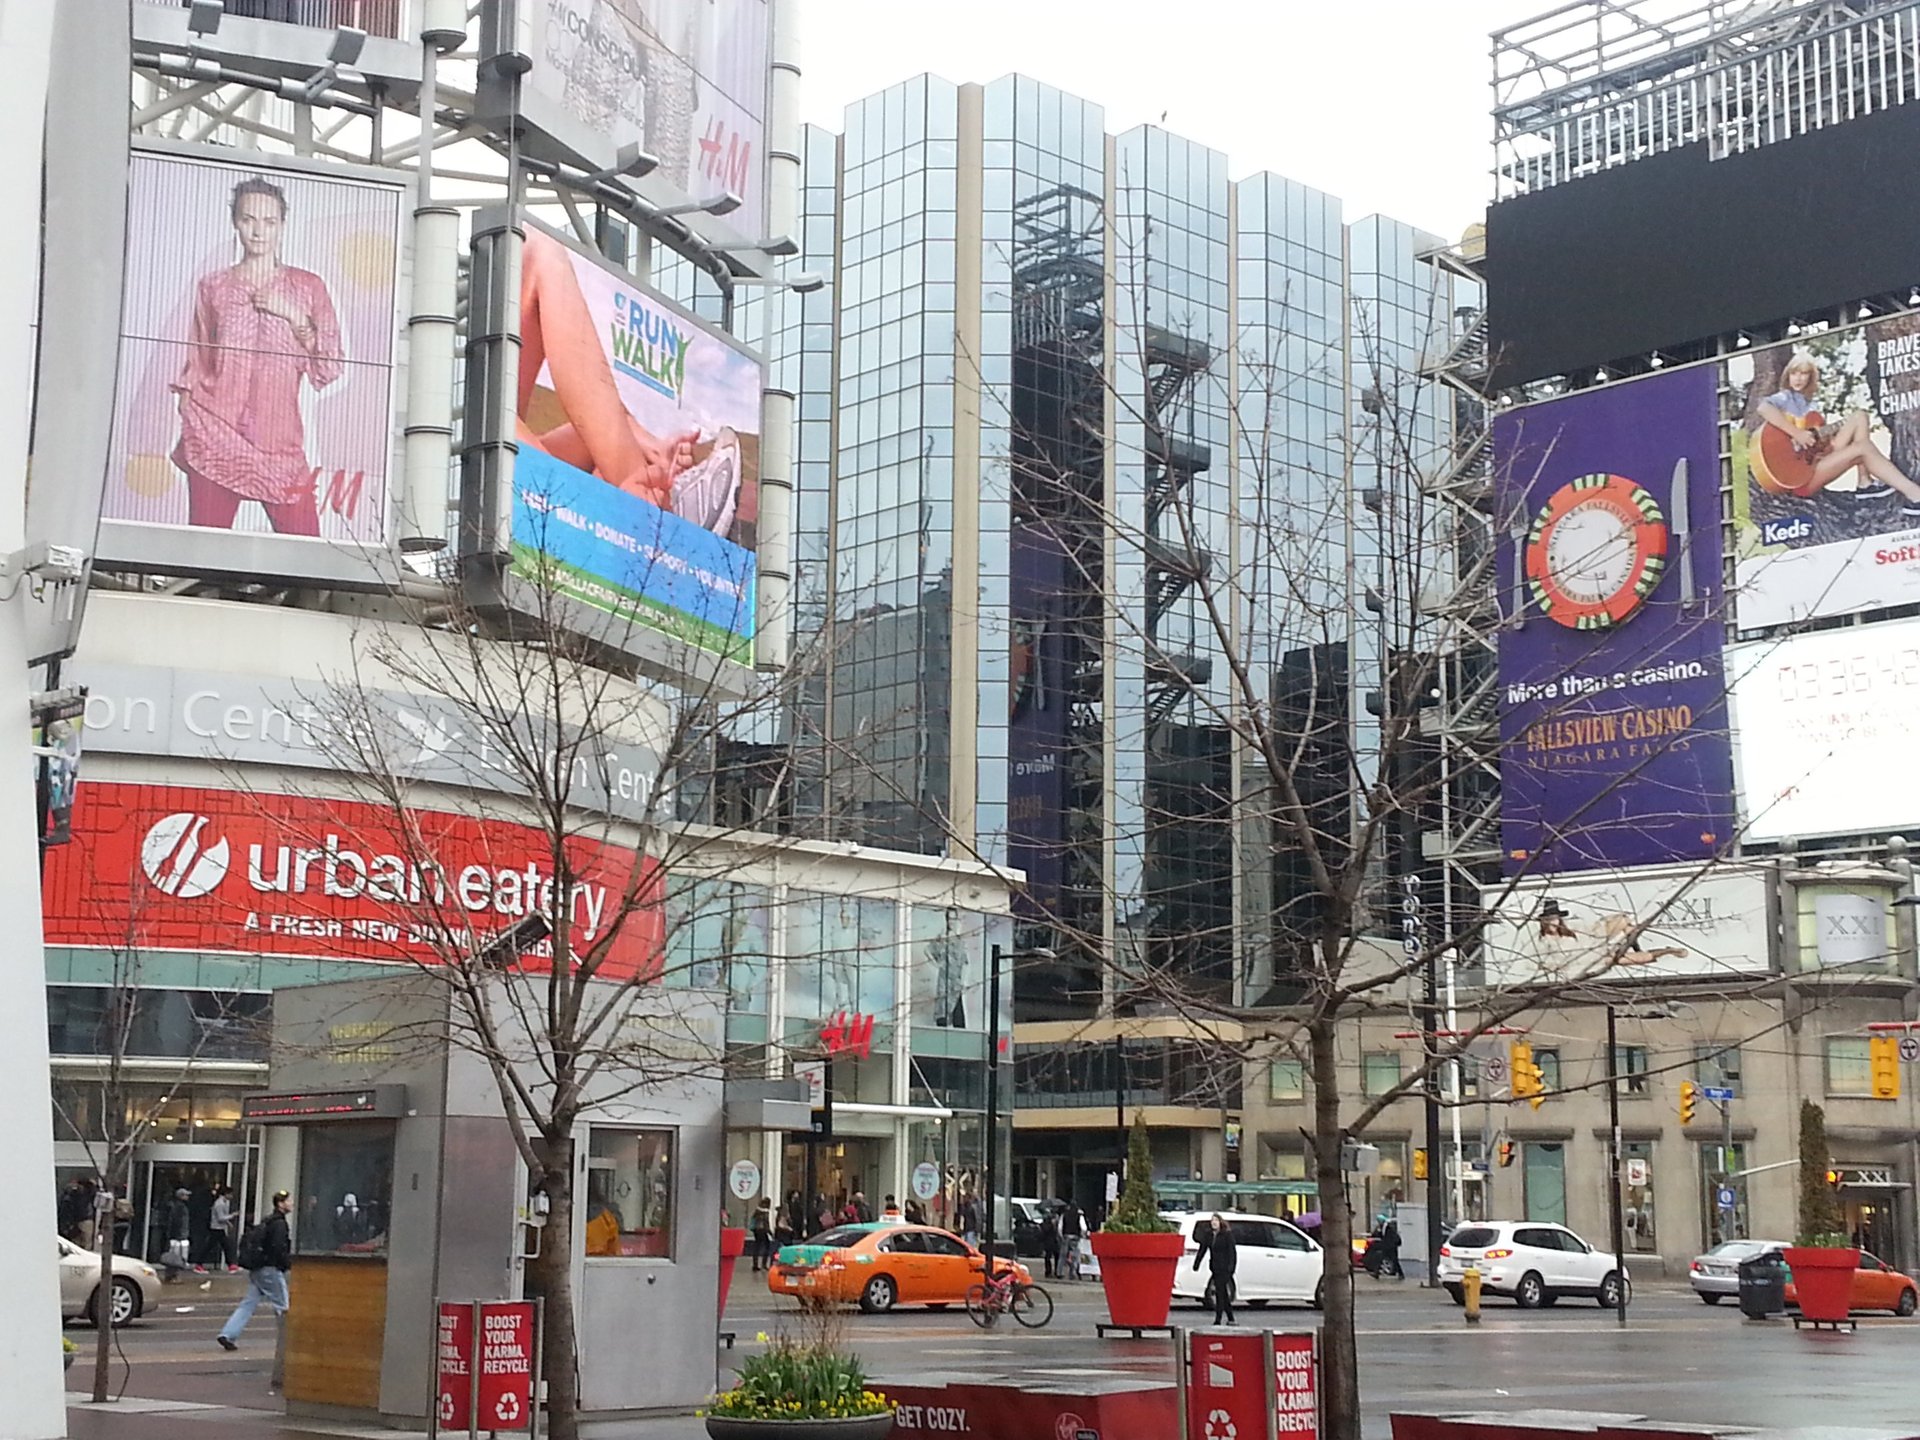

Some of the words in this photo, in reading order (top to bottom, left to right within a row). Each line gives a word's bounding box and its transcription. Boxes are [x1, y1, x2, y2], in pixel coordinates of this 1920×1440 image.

[630, 299, 676, 357] RUN
[611, 322, 675, 390] WALK
[1878, 333, 1920, 360] BRAVE
[1878, 352, 1920, 377] TAKES
[1879, 378, 1889, 397] A
[1880, 390, 1920, 415] CHAN
[556, 505, 588, 532] WALK
[595, 521, 637, 553] DONATE
[1765, 520, 1810, 543] Keds
[1875, 544, 1920, 565] Soft
[1508, 683, 1558, 704] More
[1562, 675, 1608, 696] than
[1613, 671, 1626, 689] a
[1631, 660, 1709, 686] casino.
[1622, 704, 1692, 740] CASINO
[1528, 745, 1620, 768] NIAGARA
[249, 834, 445, 906] urban
[458, 861, 606, 942] eatery
[244, 911, 259, 933] A
[270, 914, 343, 938] FRESH
[352, 919, 400, 942] NEW
[1826, 915, 1880, 935] XXI
[1857, 1170, 1891, 1184] XXI
[485, 1315, 522, 1330] BOOST
[485, 1330, 516, 1345] YOUR
[1276, 1350, 1312, 1370] BOOST
[1277, 1371, 1309, 1390] YOUR
[896, 1405, 923, 1429] GET
[926, 1406, 971, 1432] COZY.
[1279, 1411, 1317, 1432] RECYC
